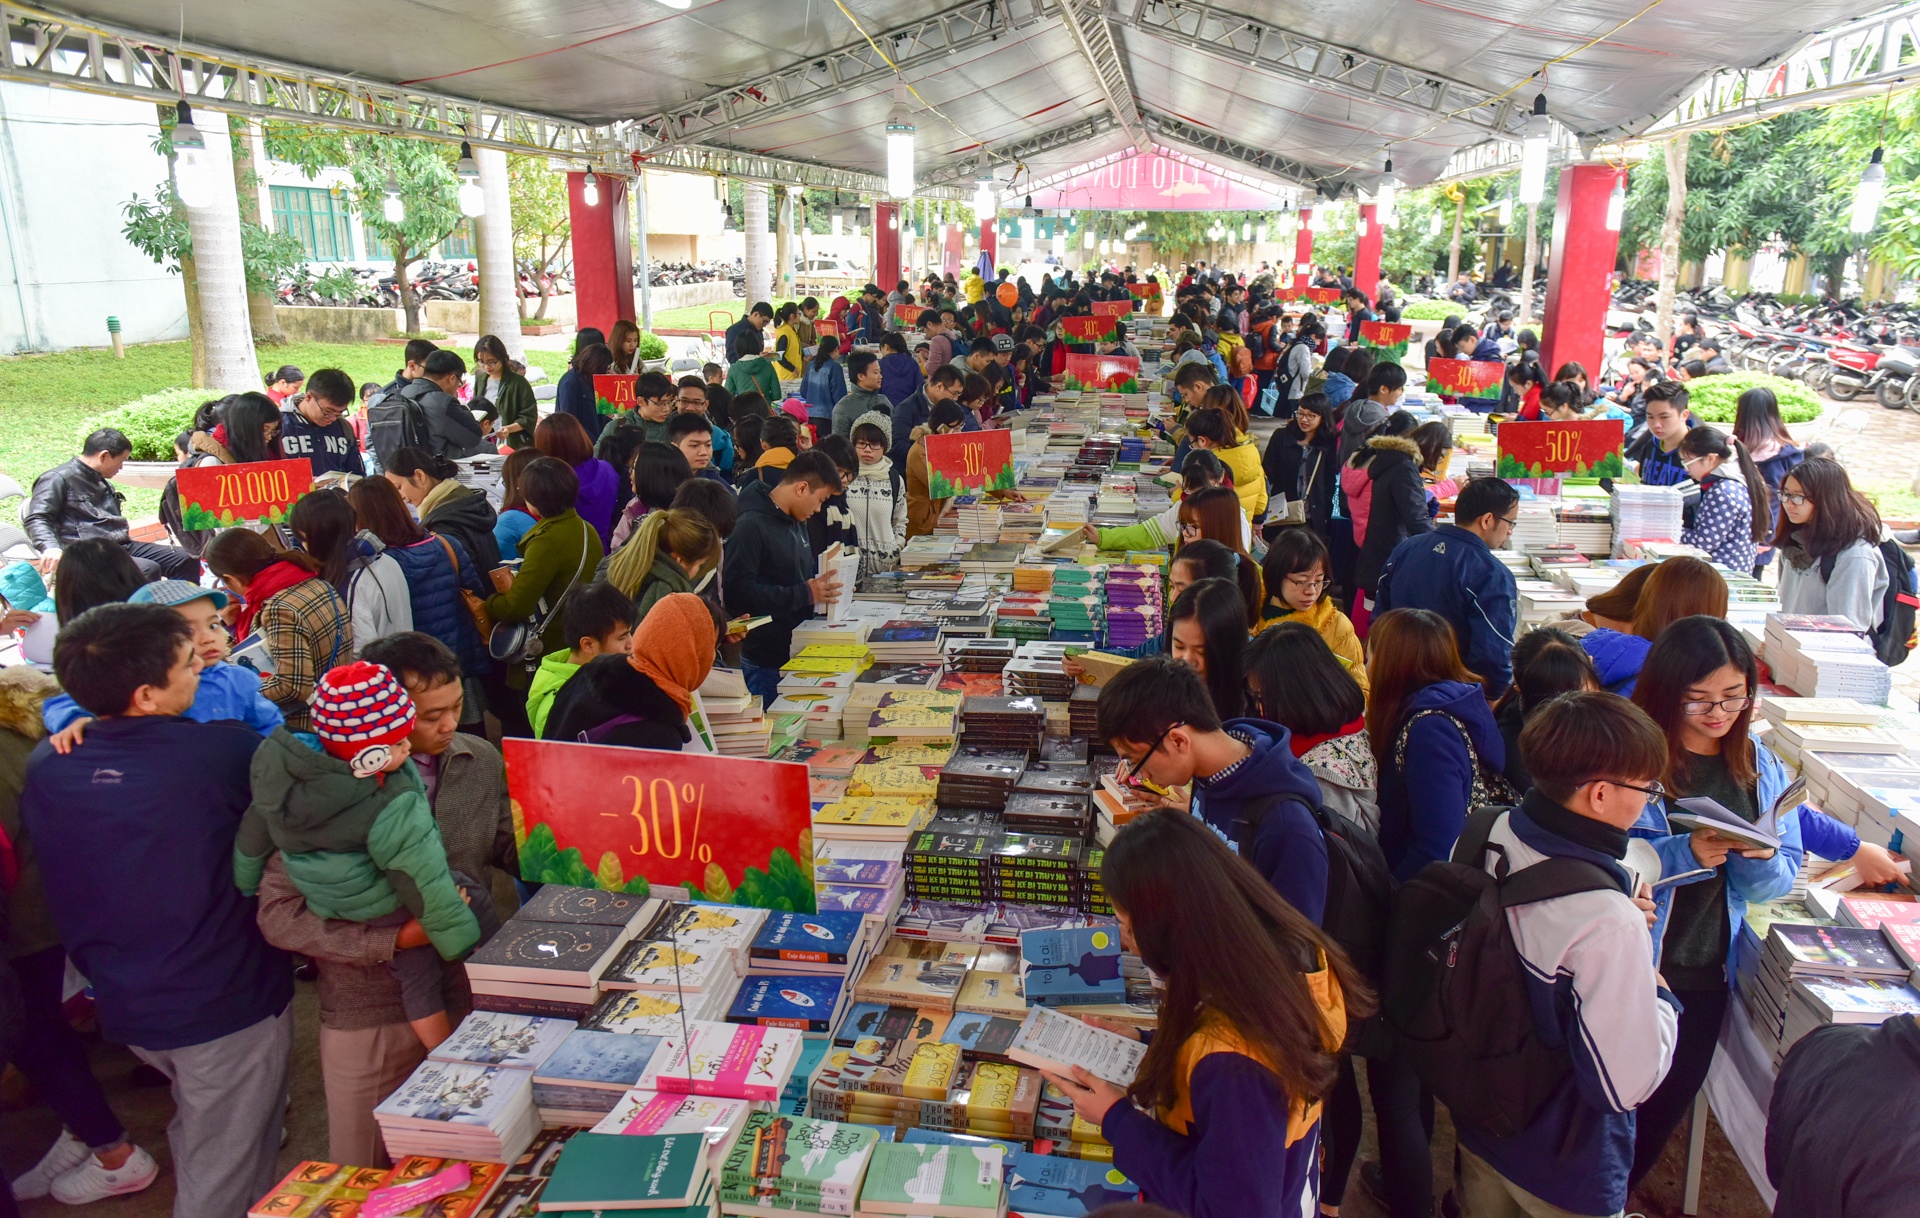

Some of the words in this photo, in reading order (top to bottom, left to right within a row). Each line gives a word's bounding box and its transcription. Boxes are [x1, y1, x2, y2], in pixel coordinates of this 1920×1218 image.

[1535, 430, 1582, 462] -50%
[955, 442, 987, 477] -30%
[600, 775, 712, 864] -30%
[927, 1062, 948, 1087] 2013
[991, 1082, 1011, 1108] 2013
[724, 1148, 749, 1173] KEN
[726, 1174, 740, 1182] KEN
[724, 1192, 738, 1200] KEN
